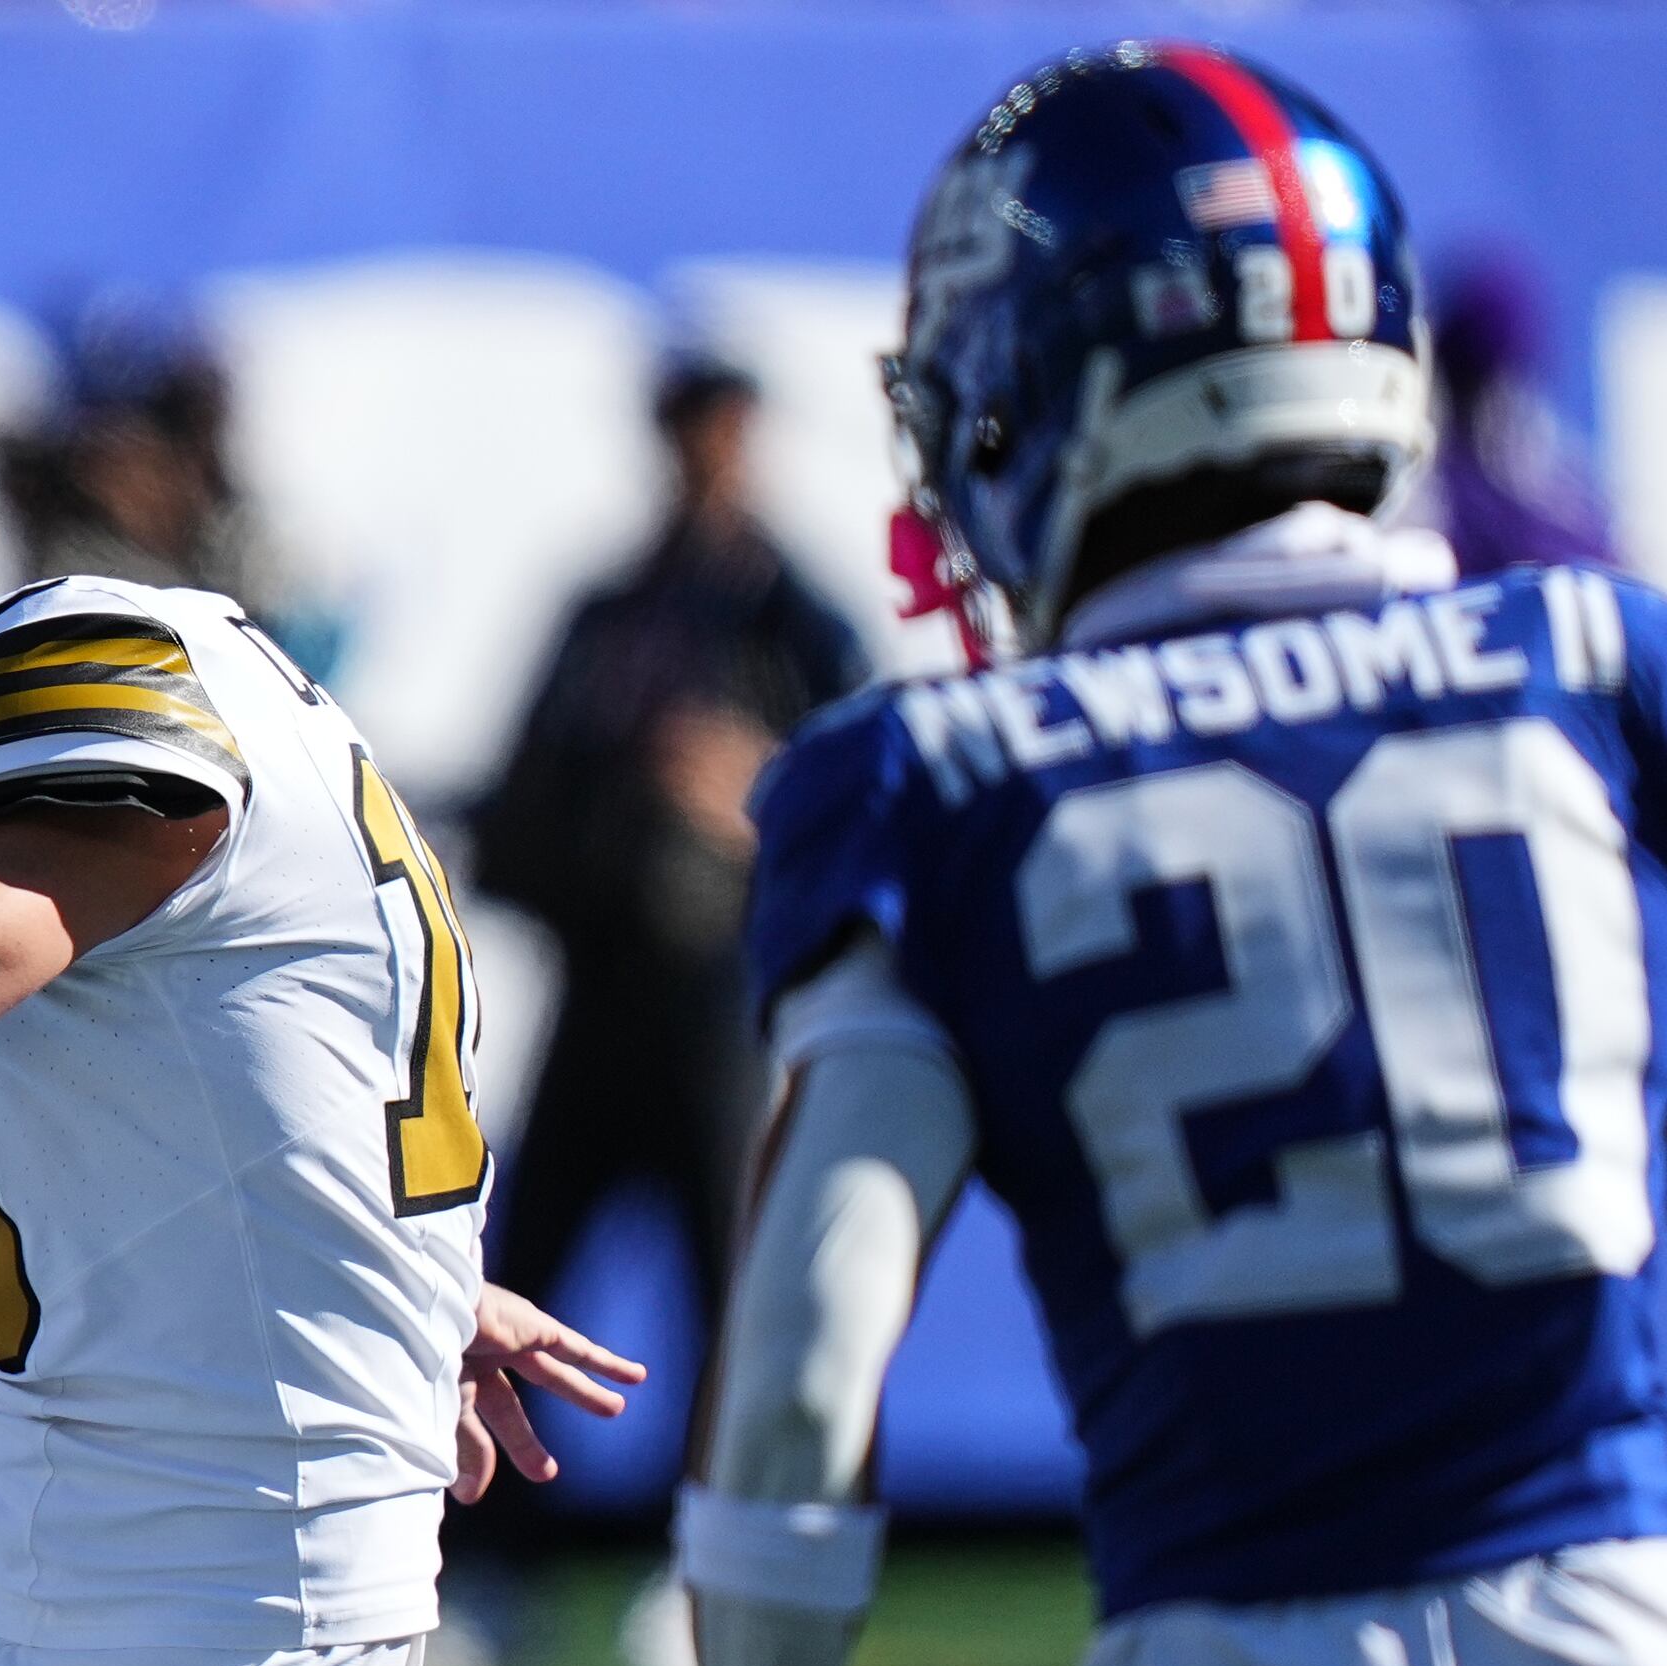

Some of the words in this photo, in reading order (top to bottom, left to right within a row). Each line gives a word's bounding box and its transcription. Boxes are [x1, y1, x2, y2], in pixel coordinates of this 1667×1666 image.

[1234, 243, 1377, 344] 20
[893, 580, 1531, 808] NEWSOME
[1539, 565, 1627, 697] II
[1016, 716, 1657, 1338] 20
